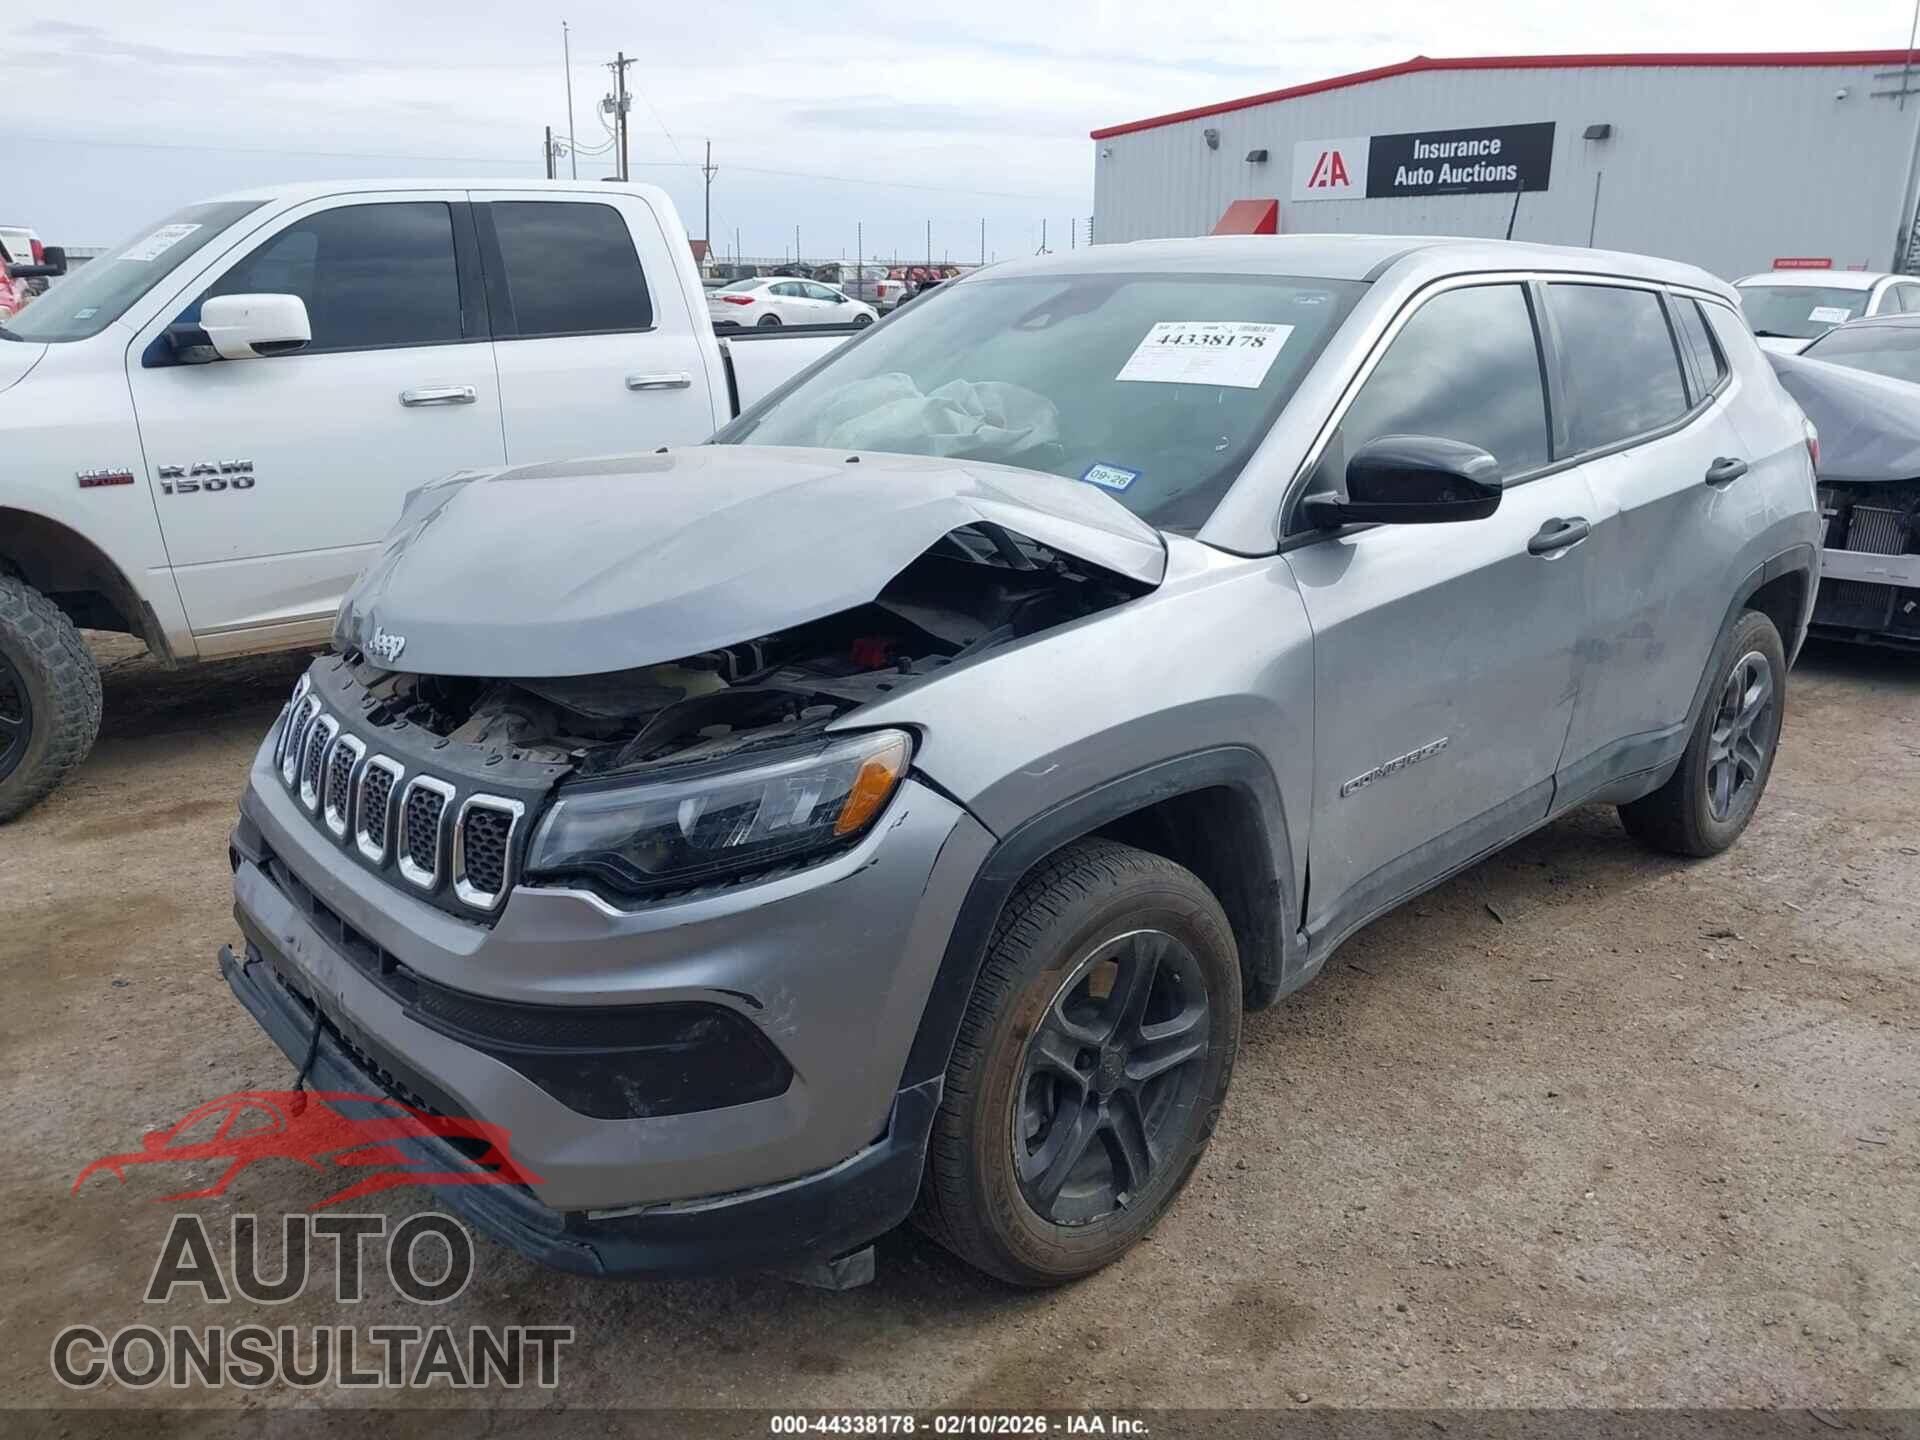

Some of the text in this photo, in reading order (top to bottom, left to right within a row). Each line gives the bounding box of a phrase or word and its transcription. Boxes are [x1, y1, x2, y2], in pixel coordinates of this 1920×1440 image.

[1413, 138, 1502, 160] Insurance
[1394, 161, 1518, 186] Auto Auctions
[1156, 334, 1267, 348] 44338178
[159, 459, 254, 479] RAM
[159, 475, 255, 495] 1500
